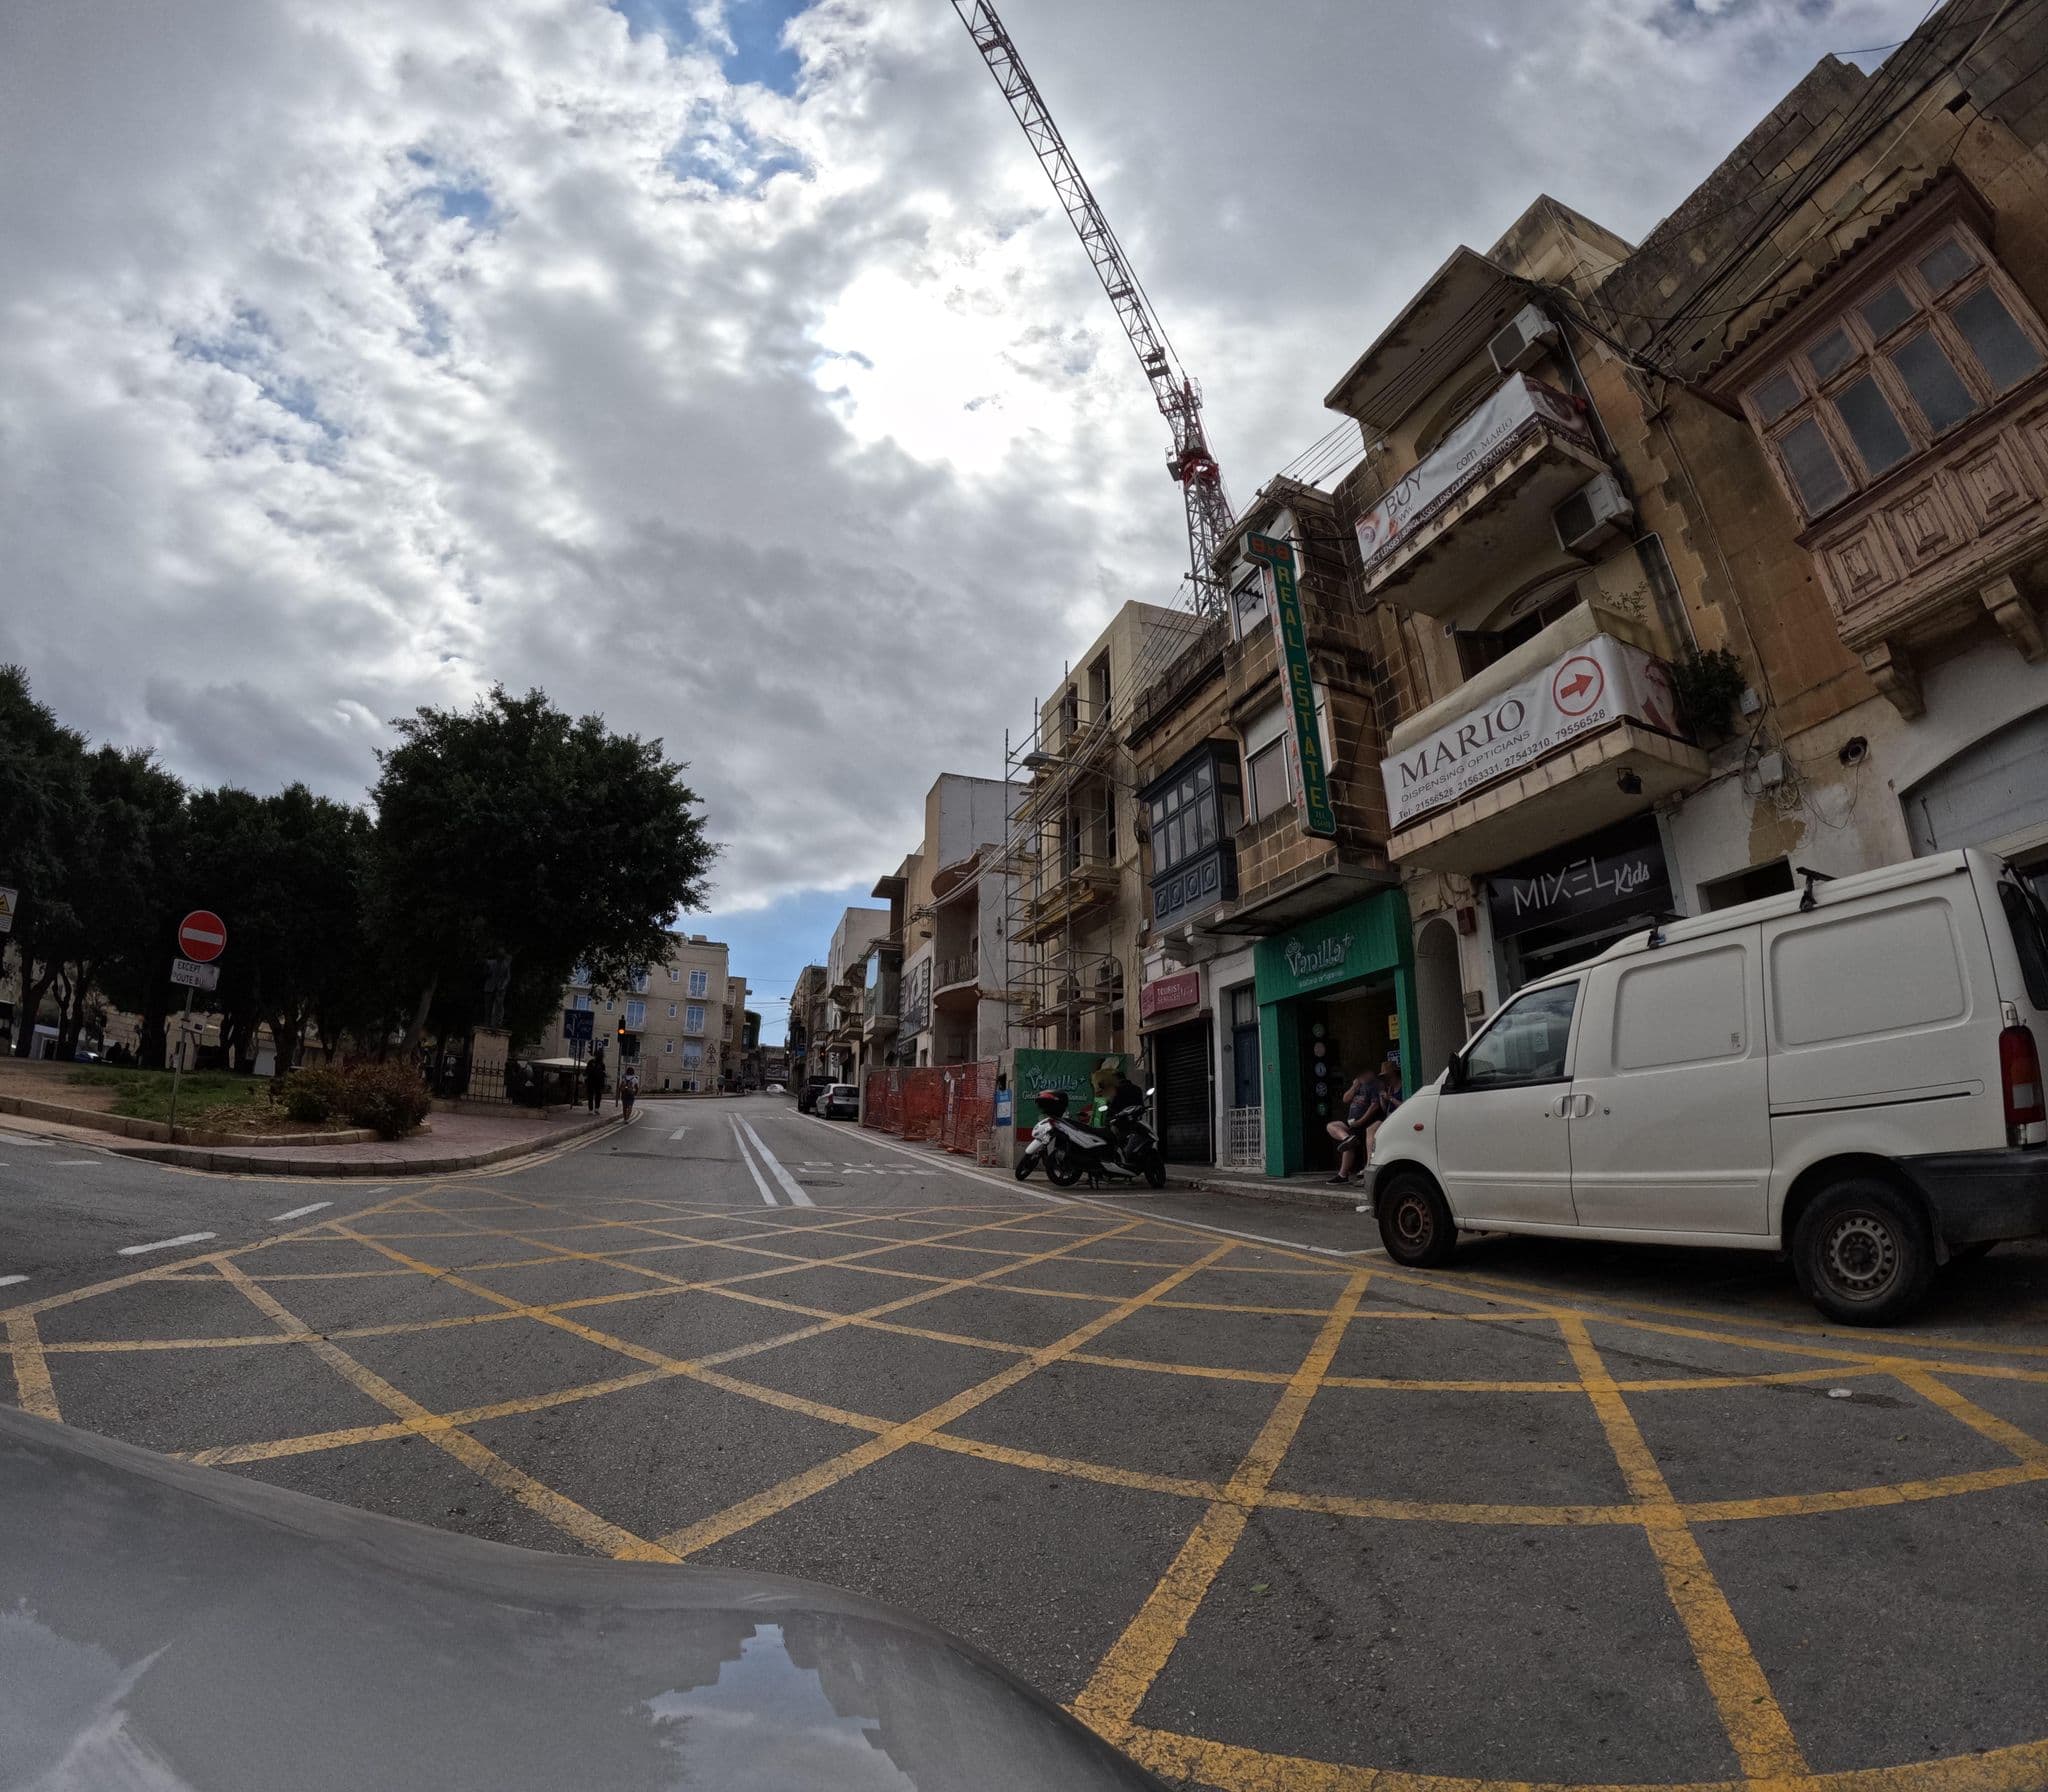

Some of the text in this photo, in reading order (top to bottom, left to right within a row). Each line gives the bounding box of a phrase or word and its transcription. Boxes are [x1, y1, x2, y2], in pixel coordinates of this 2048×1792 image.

[1480, 417, 1513, 449] MARIO
[1385, 467, 1423, 516] BUY
[1438, 489, 1452, 505] LENS
[1452, 464, 1483, 494] CLEANING
[1482, 432, 1519, 466] SOLUTIONS
[1277, 565, 1302, 648] REAL
[1292, 664, 1325, 809] ESTATE
[1399, 699, 1525, 788] MARIO
[1401, 730, 1531, 803] DISPENSING OPTICIANS
[1504, 738, 1553, 768] 27543210,
[1555, 709, 1606, 741] 79556528
[1513, 856, 1651, 916] MIXEL Kids
